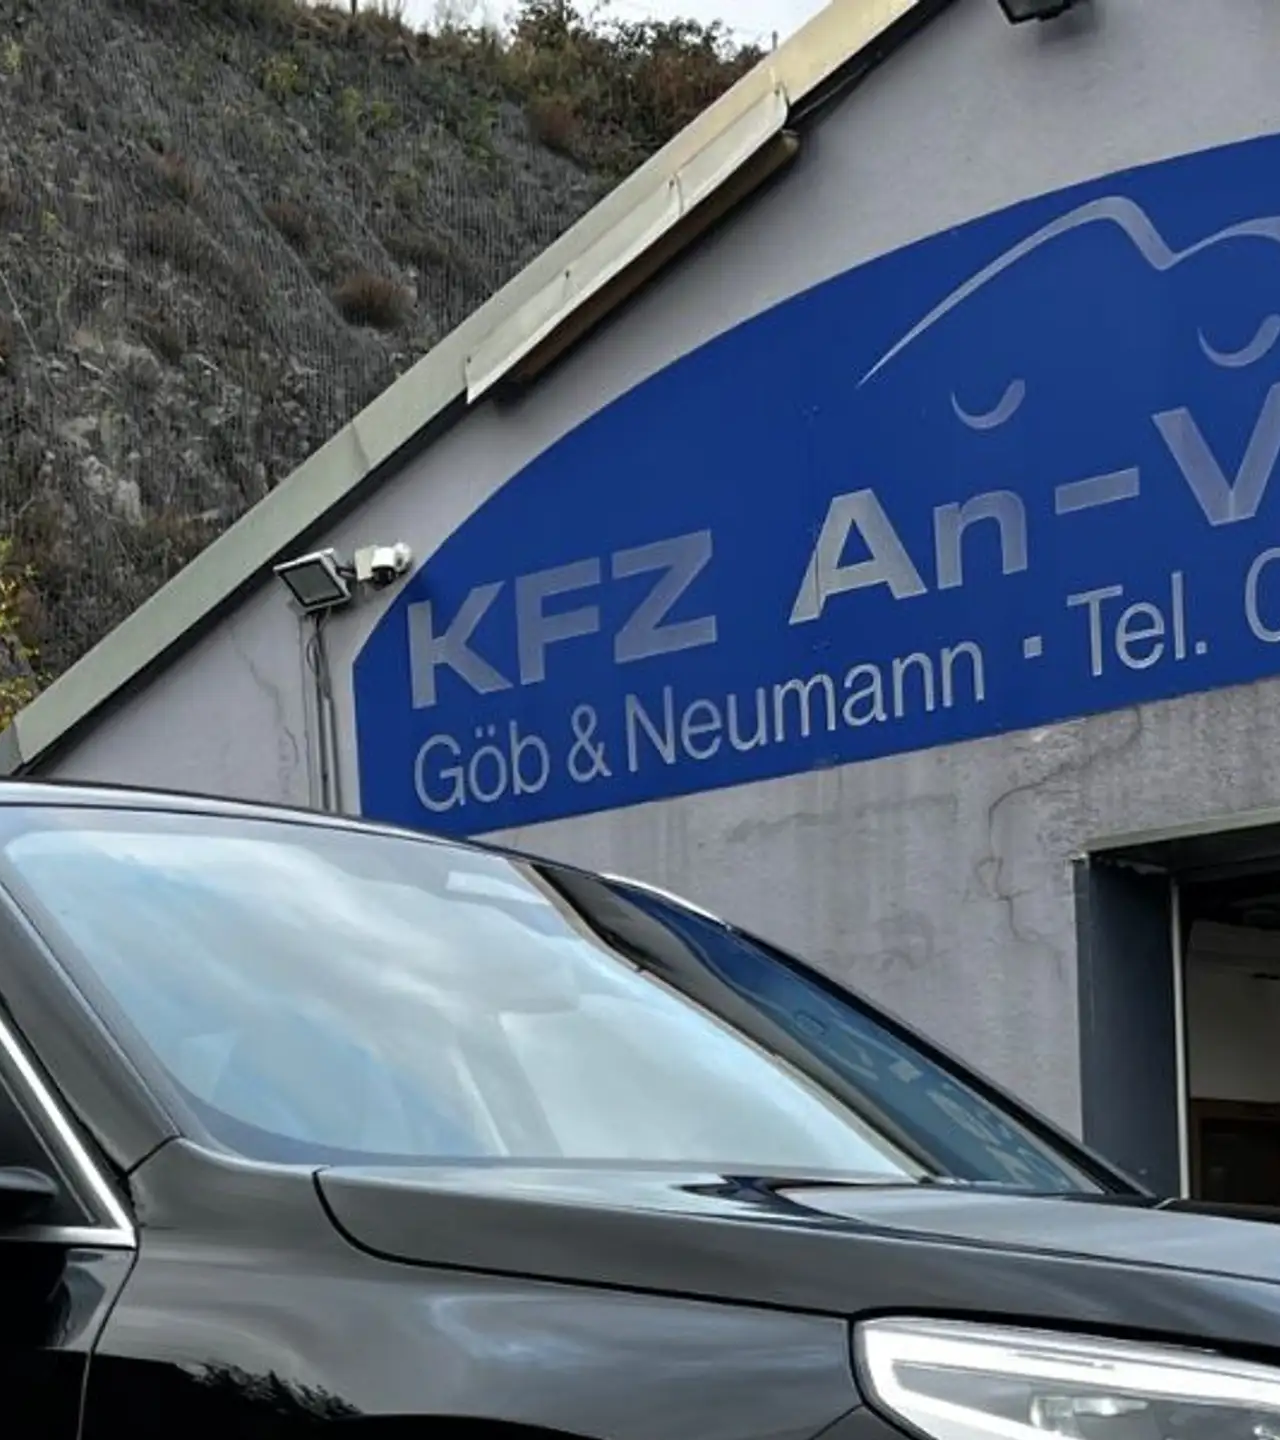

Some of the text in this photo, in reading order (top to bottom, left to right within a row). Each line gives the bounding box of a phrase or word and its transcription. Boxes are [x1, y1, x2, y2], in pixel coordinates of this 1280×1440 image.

[407, 532, 717, 709] KFZ
[415, 721, 549, 812] Göb
[568, 706, 612, 782] &
[626, 641, 985, 772] Neumann
[1067, 571, 1209, 677] Tel.
